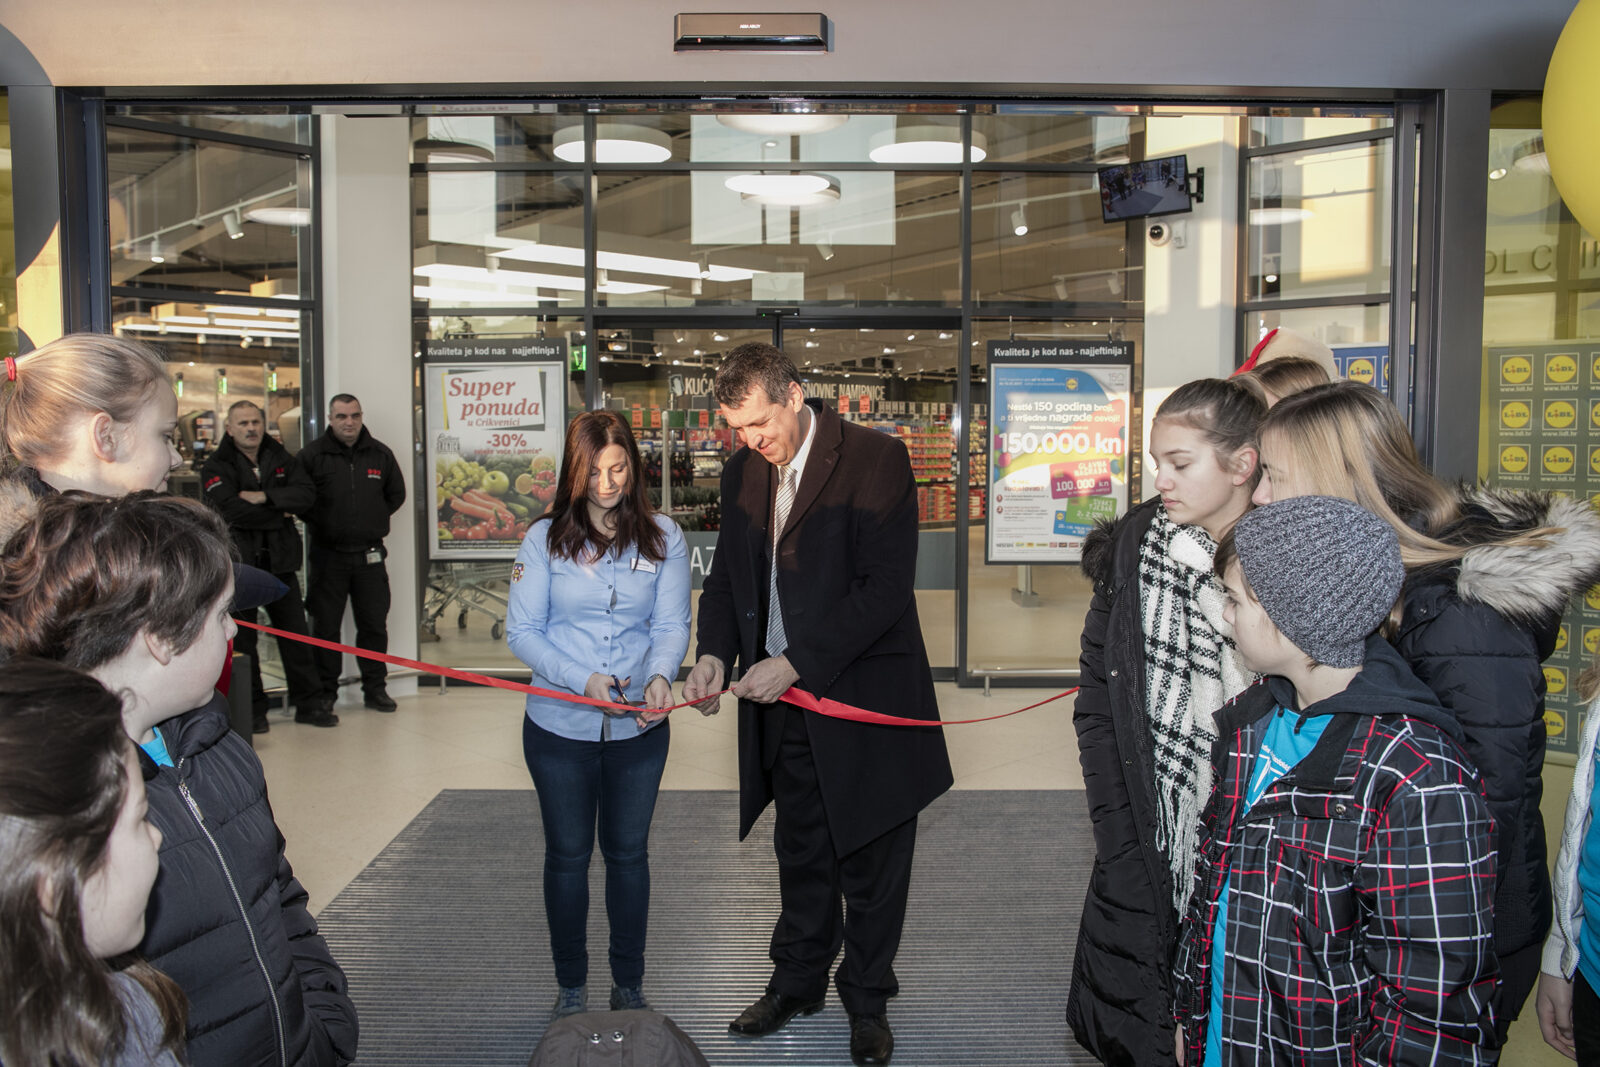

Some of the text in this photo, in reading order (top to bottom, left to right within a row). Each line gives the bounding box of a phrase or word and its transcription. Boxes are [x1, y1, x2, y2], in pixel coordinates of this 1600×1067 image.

[427, 346, 462, 356] Kvaliteta
[464, 346, 472, 357] je
[474, 346, 490, 355] kod
[512, 346, 555, 357] najjeftinija
[994, 348, 1030, 357] Kvaliteta
[1032, 347, 1040, 358] je
[1042, 347, 1057, 356] kod
[1080, 347, 1122, 357] najjeftinija
[448, 377, 516, 400] Super
[801, 383, 886, 401] SNOVNE NAMIRNICE
[460, 398, 540, 420] ponuda
[1034, 402, 1052, 411] 150
[1055, 402, 1092, 413] godina
[476, 418, 520, 427] Crikvenici
[1014, 414, 1047, 423] vrijedne
[1049, 413, 1092, 424] nagrade
[486, 434, 527, 447] -30%
[999, 432, 1122, 454] 150.000 kn
[1056, 479, 1095, 492] 100.000
